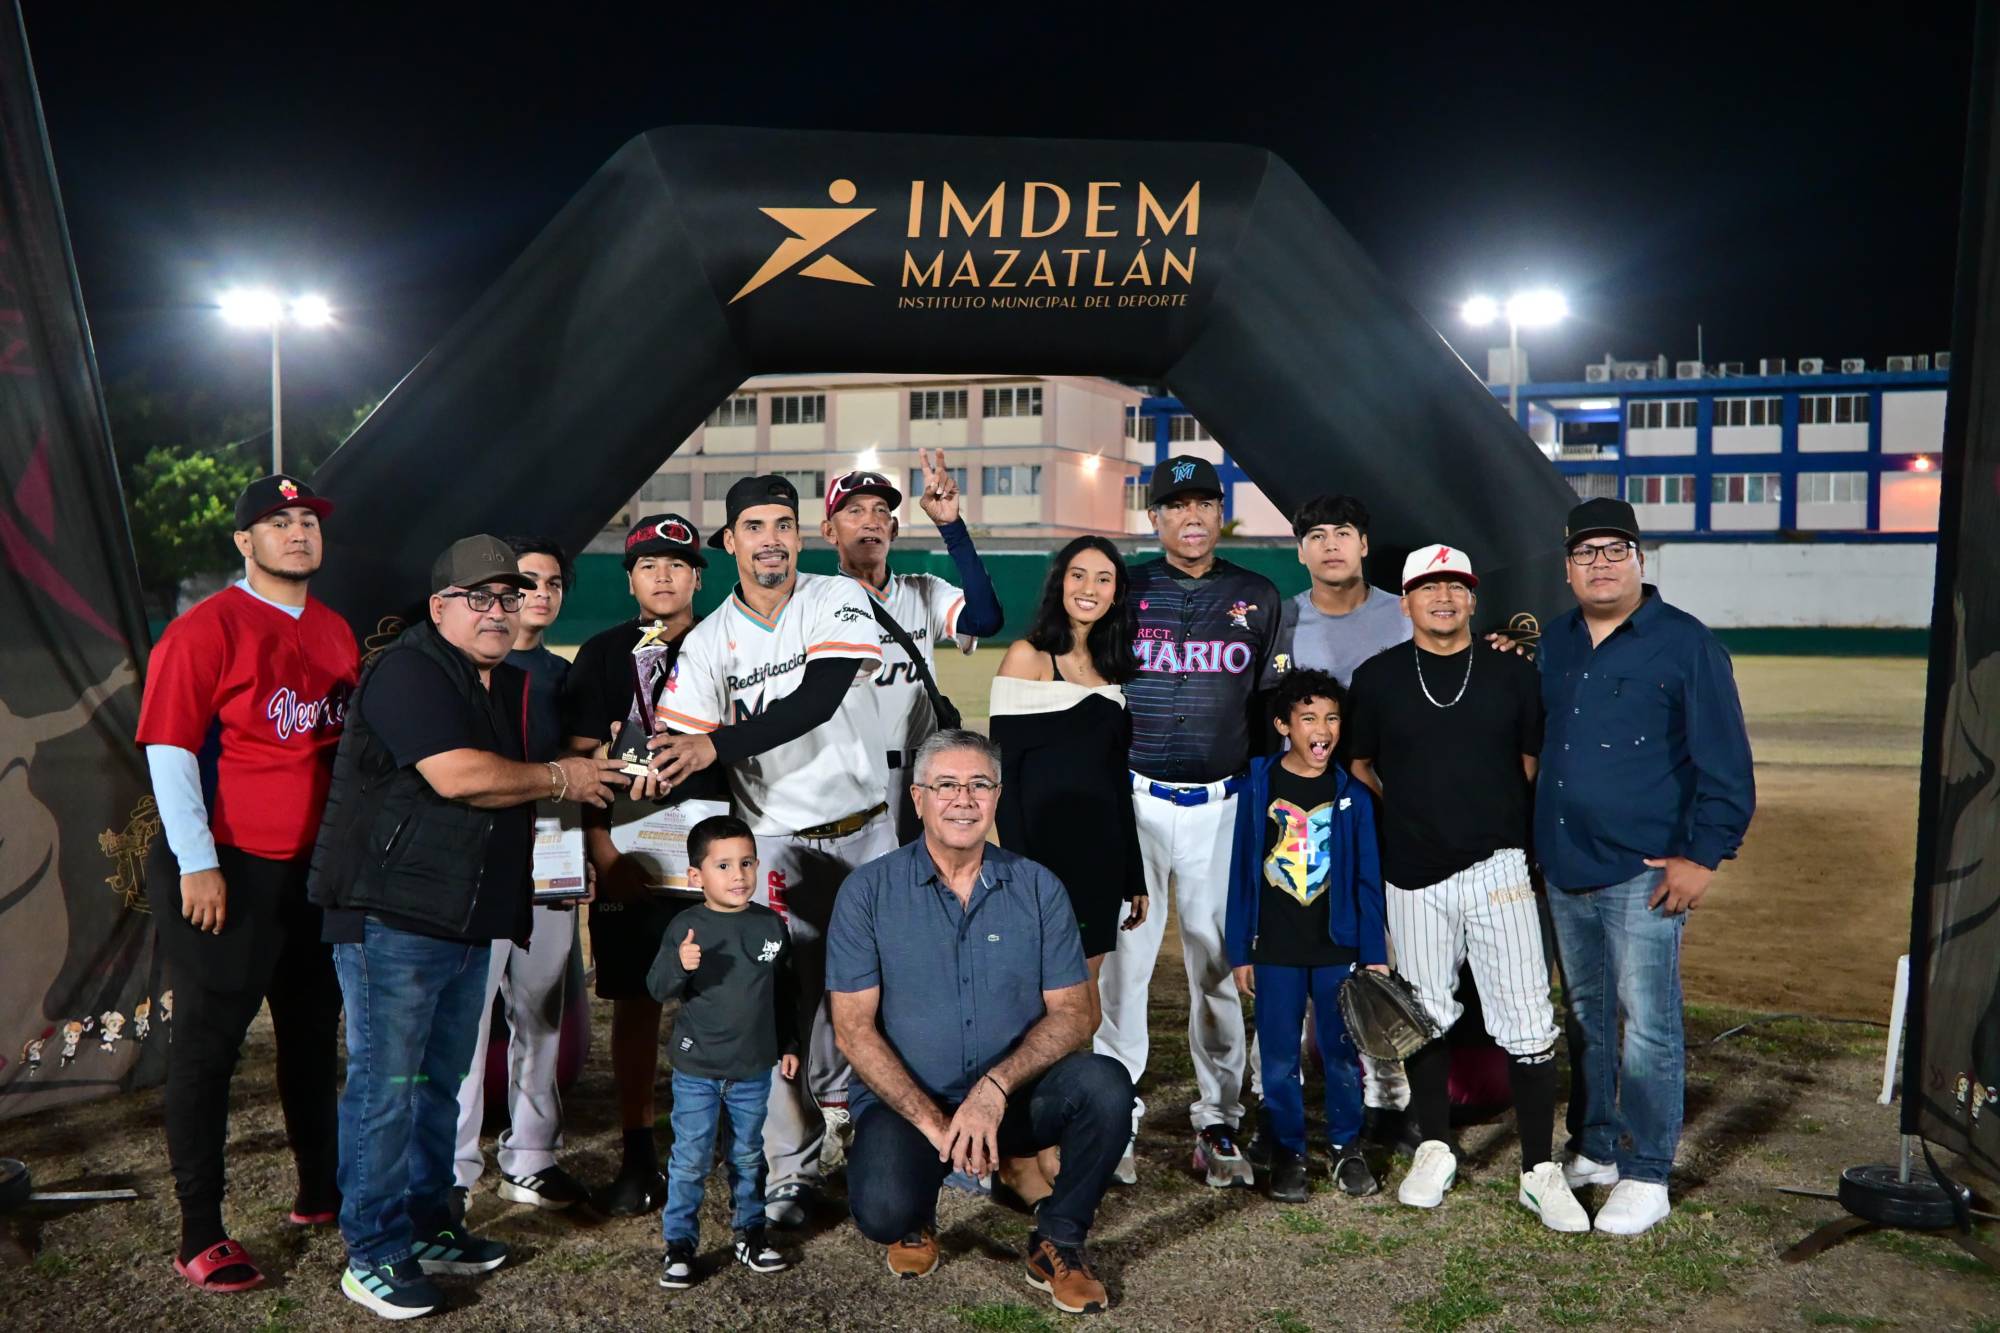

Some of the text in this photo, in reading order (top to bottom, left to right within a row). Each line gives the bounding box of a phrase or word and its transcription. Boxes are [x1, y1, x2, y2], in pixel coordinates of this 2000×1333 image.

[907, 179, 1201, 239] IMDEM
[901, 238, 1197, 289] MAZATLÁN
[898, 294, 1188, 309] INSTITUTO MUNICIPAL DEL DEPORTE
[1132, 640, 1252, 674] MARIO
[1298, 838, 1316, 865] H
